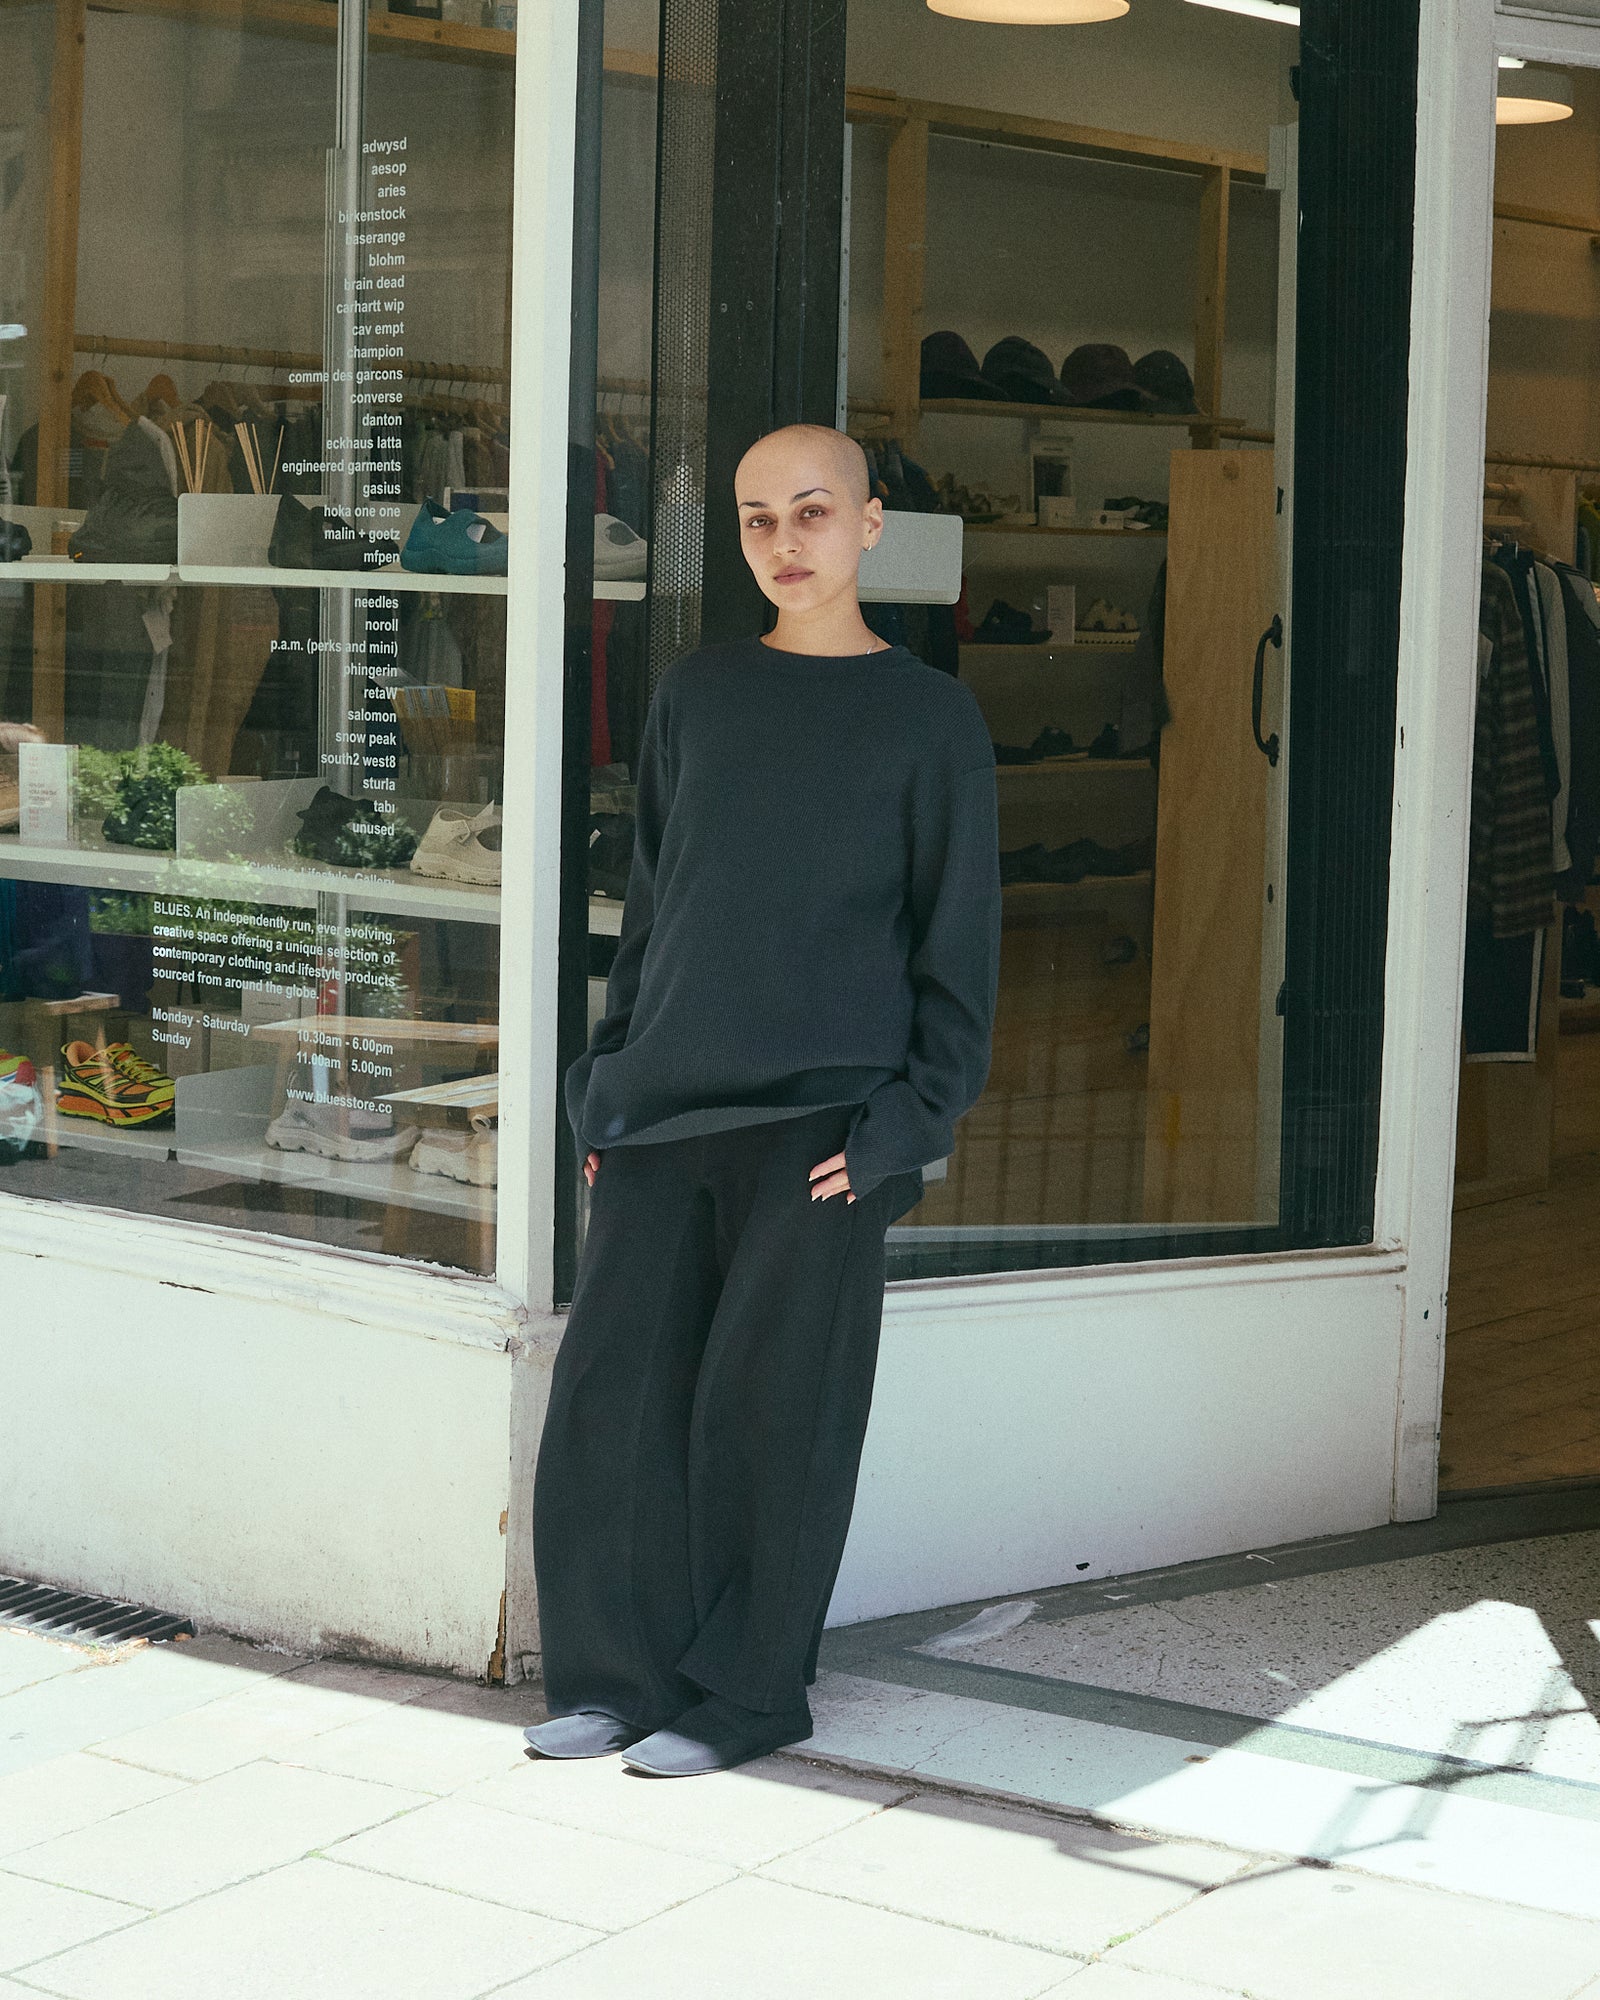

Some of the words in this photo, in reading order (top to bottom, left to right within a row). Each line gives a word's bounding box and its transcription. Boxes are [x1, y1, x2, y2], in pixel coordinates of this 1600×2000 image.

[363, 137, 407, 154] adwysd
[372, 162, 406, 176] aesop
[378, 185, 406, 197] aries
[345, 232, 406, 246] baserange
[369, 254, 405, 266] blohm
[344, 276, 373, 290] brain
[376, 274, 404, 289] dead
[336, 300, 382, 314] carhartt
[384, 298, 404, 314] wip
[352, 325, 372, 336] cav
[374, 322, 404, 338] empt
[346, 344, 404, 360] champion
[289, 372, 330, 383] comme
[333, 369, 353, 381] des
[356, 370, 403, 384] garcons
[350, 393, 403, 404] converse
[362, 413, 402, 426] danton
[326, 436, 373, 449] eckhaus
[377, 436, 402, 449] latta
[282, 459, 344, 475] engineered
[348, 459, 401, 475] garments
[363, 481, 401, 497] gasius
[324, 505, 351, 517] hoka
[355, 507, 375, 517] one
[379, 507, 400, 517] one
[325, 527, 355, 539] malin
[369, 528, 400, 543] goetz
[364, 550, 400, 566] mfpen
[354, 595, 399, 609] needles
[365, 619, 398, 631] noroll
[270, 640, 304, 652] p.a.m.
[307, 638, 341, 654] (perks
[345, 640, 366, 653] and
[369, 641, 398, 657] mini)
[344, 663, 398, 679] phingerin
[364, 686, 398, 699] retaW
[348, 708, 396, 722] salomon
[336, 732, 366, 743] snow
[369, 732, 396, 747] peak
[321, 752, 359, 766] south2
[362, 755, 396, 768] west8
[362, 776, 396, 790] sturla
[352, 823, 394, 836] unused
[154, 901, 193, 918] BLUES.
[196, 907, 210, 919] An
[214, 908, 289, 932] independently
[293, 921, 314, 934] run,
[317, 924, 342, 935] ever
[345, 927, 395, 945] evolving,
[153, 925, 194, 939] creative
[197, 931, 228, 944] space
[231, 933, 273, 952] offering
[276, 941, 282, 951] a
[286, 941, 323, 957] unique
[327, 947, 378, 962] selection
[383, 952, 395, 964] of
[153, 946, 225, 968] contemporary
[228, 954, 272, 974] clothing
[275, 962, 295, 974] and
[298, 963, 340, 981] lifestyle
[345, 972, 395, 987] products
[153, 968, 195, 982] sourced
[197, 971, 221, 986] from
[225, 978, 262, 992] around
[266, 981, 283, 994] the
[286, 984, 319, 1000] globe.
[152, 1007, 193, 1028] Monday
[203, 1015, 250, 1036] Saturday
[297, 1029, 342, 1046] 10.30am
[352, 1037, 393, 1055] 6.00pm
[152, 1028, 191, 1048] Sunday
[296, 1051, 341, 1068] 11.00am
[351, 1059, 392, 1077] 5.00pm
[286, 1089, 392, 1114] www.bluesstore.co
